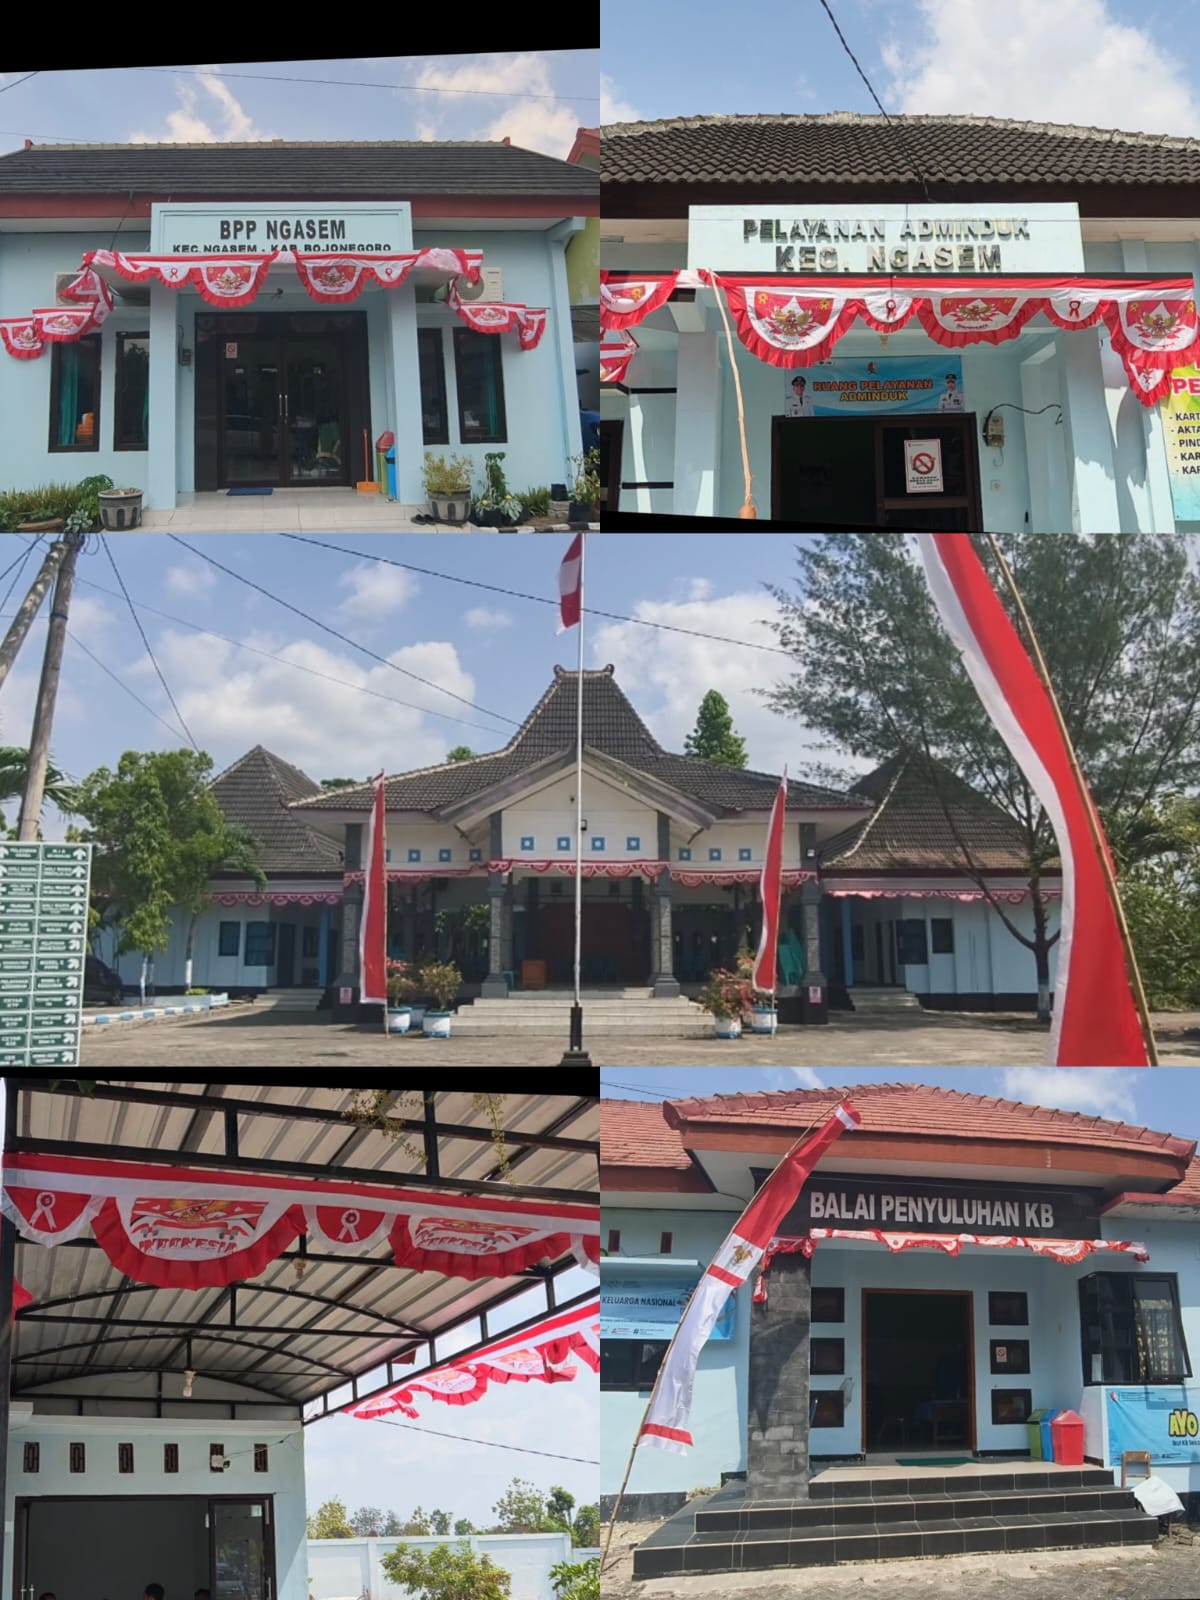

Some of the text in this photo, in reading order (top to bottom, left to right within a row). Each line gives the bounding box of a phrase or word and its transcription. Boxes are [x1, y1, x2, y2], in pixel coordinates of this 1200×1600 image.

[220, 219, 346, 240] BPP NGASEM
[743, 218, 1030, 242] PELAYANAN ADMINDUK
[303, 243, 392, 252] BOJONEGORO
[775, 244, 1001, 271] KEC. NGASEM
[813, 379, 933, 391] RUANG PELAYANAN
[840, 391, 909, 401] ADMINDUK
[810, 1191, 1054, 1228] BALAI PENYULUHAN KB
[602, 1296, 676, 1307] KELUARGA NASIONAL
[1168, 1408, 1199, 1438] AYO
